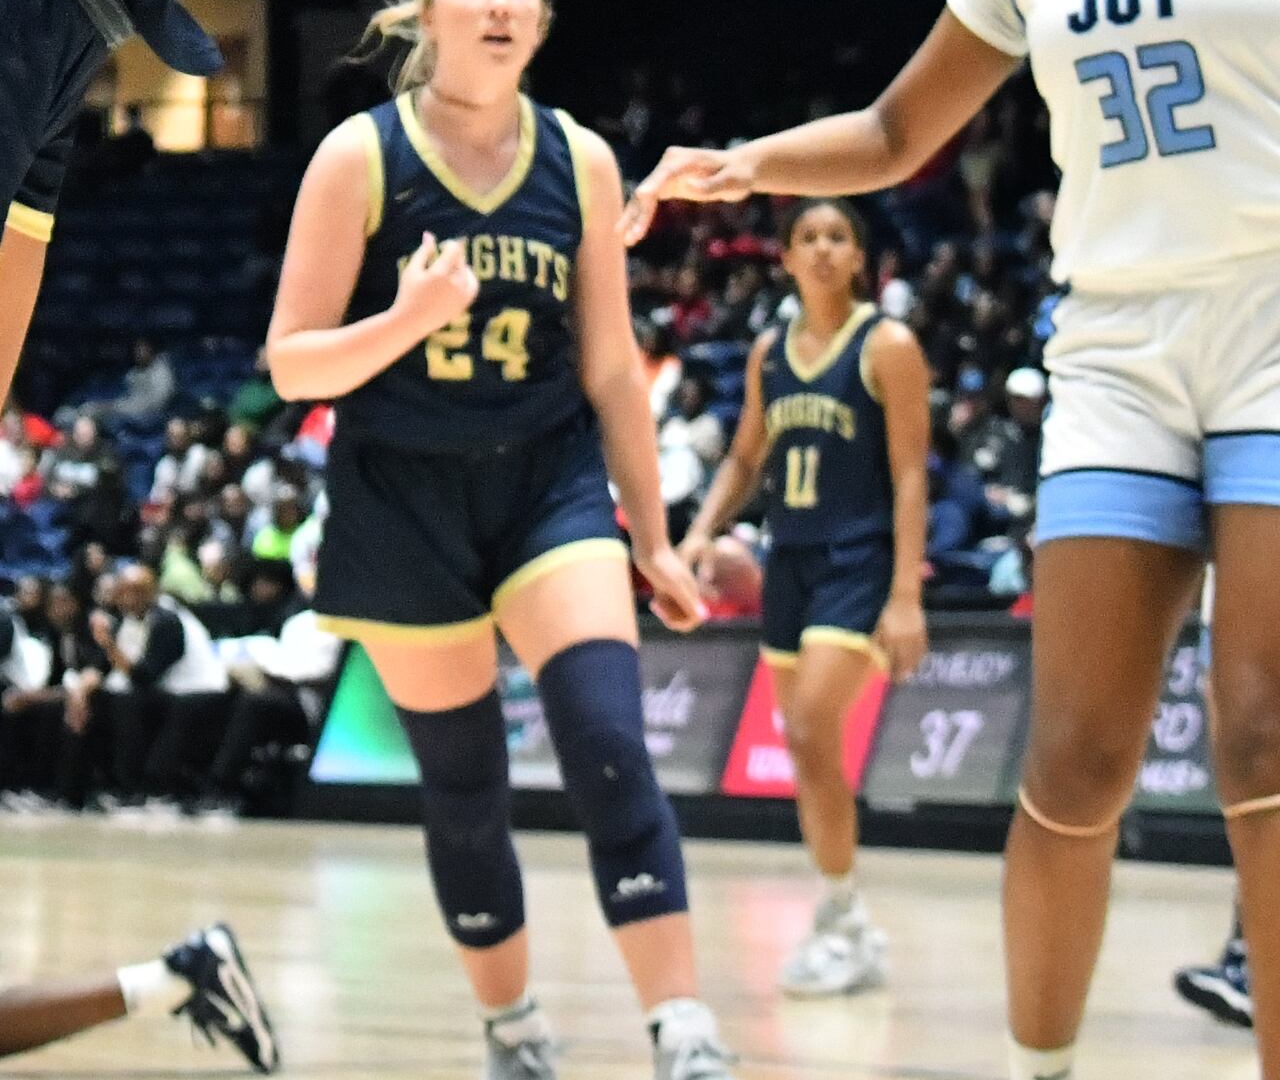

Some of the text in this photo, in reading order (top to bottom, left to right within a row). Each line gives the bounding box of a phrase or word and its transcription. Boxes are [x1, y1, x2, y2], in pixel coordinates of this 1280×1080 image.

[1074, 39, 1216, 169] 32
[397, 234, 570, 302] GHTS
[425, 308, 531, 382] 24
[784, 445, 819, 509] 11
[905, 651, 1017, 686] OVEJOY
[910, 708, 985, 778] 37
